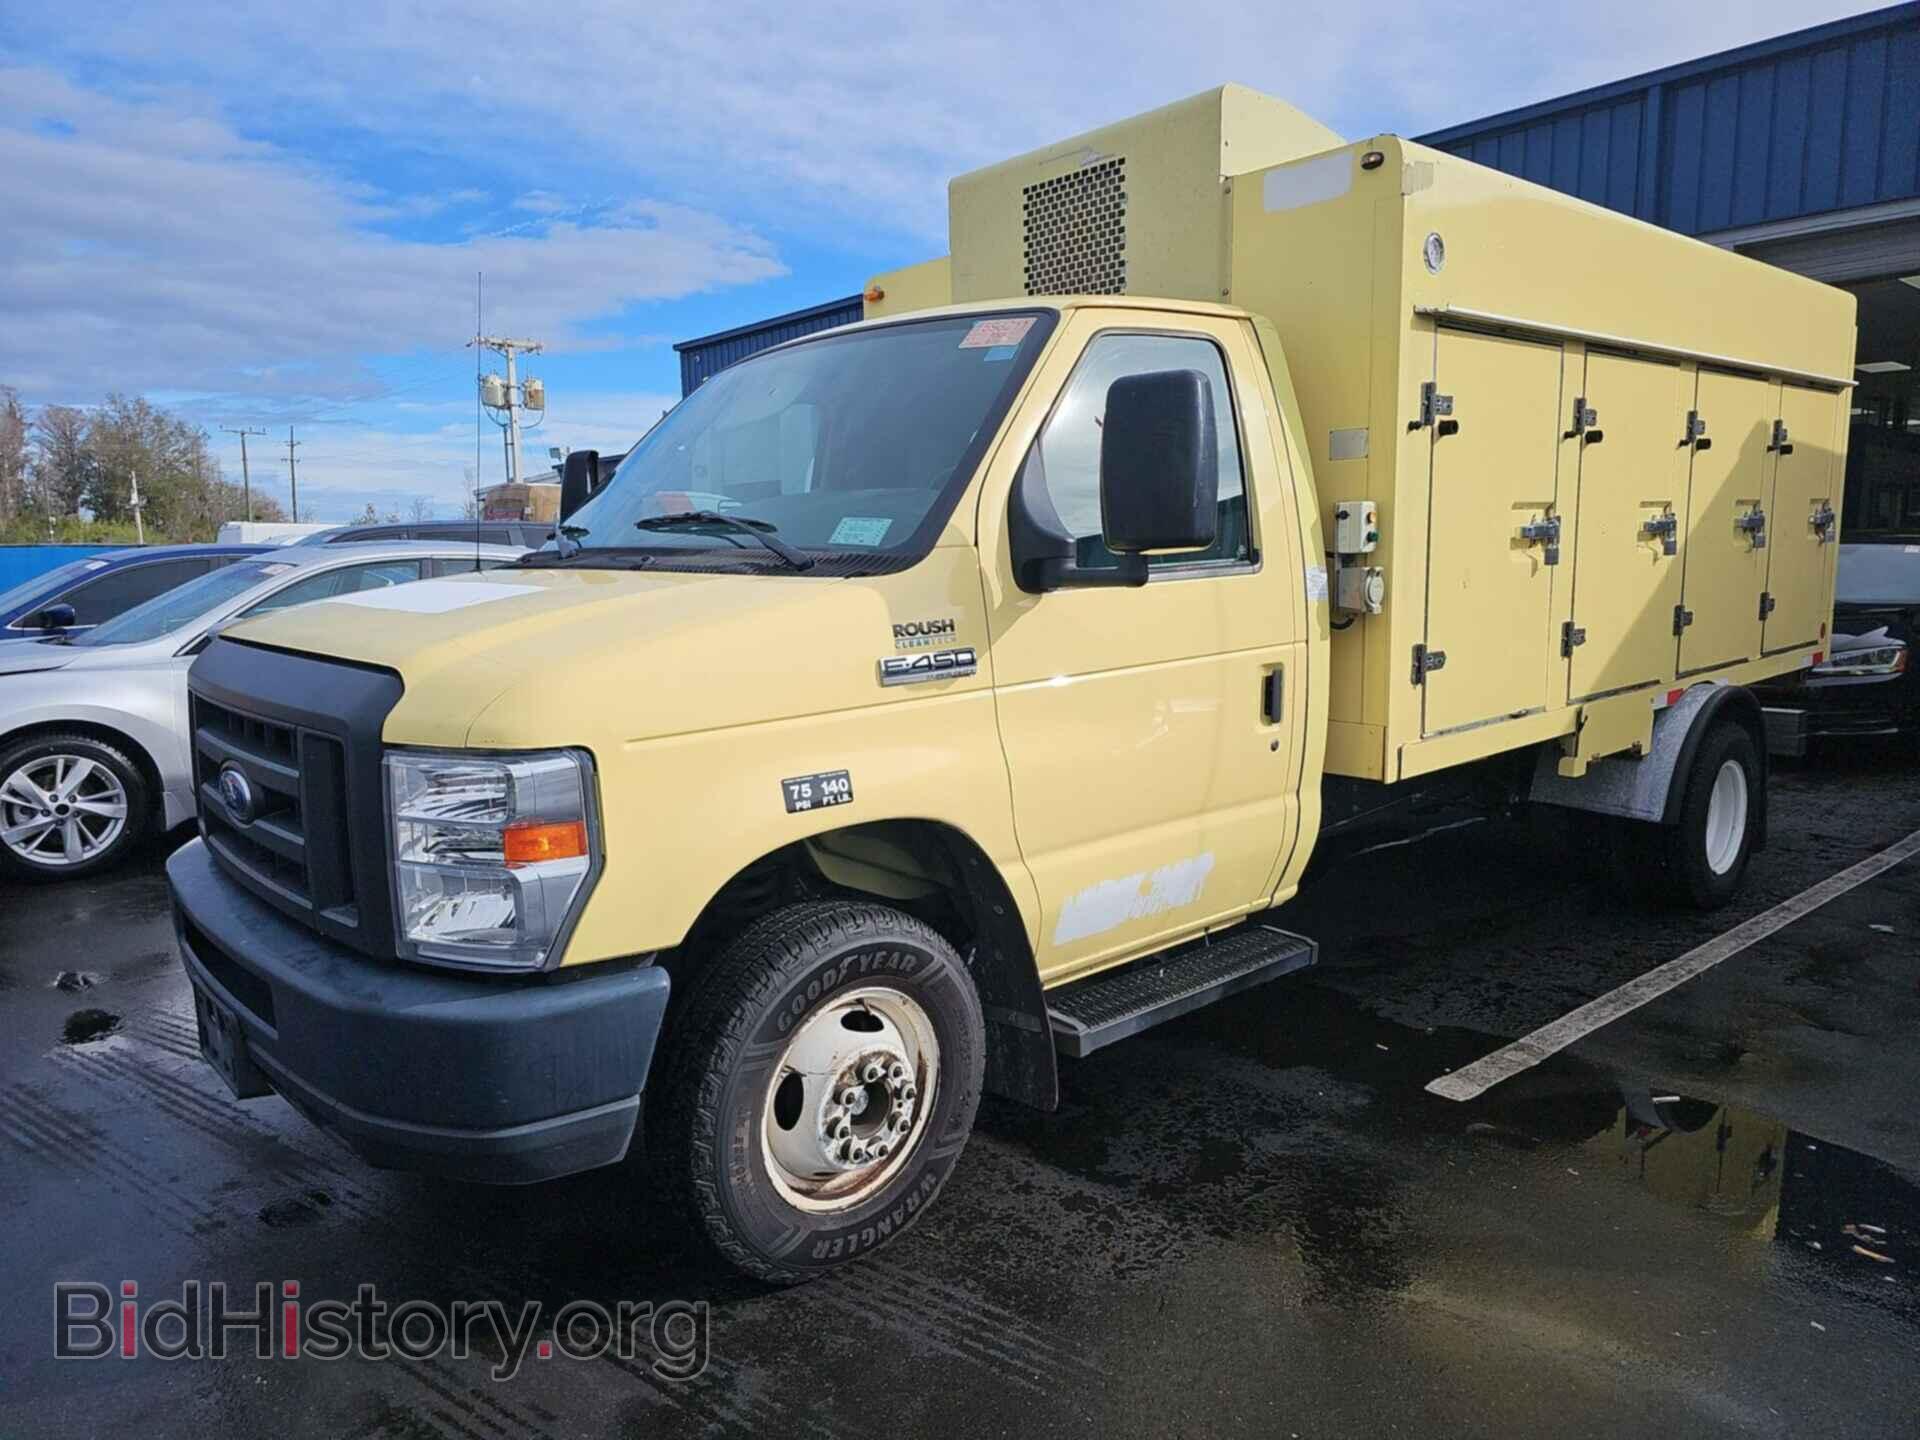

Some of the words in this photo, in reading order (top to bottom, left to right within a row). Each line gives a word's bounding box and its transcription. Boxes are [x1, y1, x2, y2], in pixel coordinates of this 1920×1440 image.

[892, 618, 955, 637] ROUSH
[789, 783, 812, 800] 75
[821, 778, 849, 795] 140
[812, 1173, 938, 1259] WRANGLER
